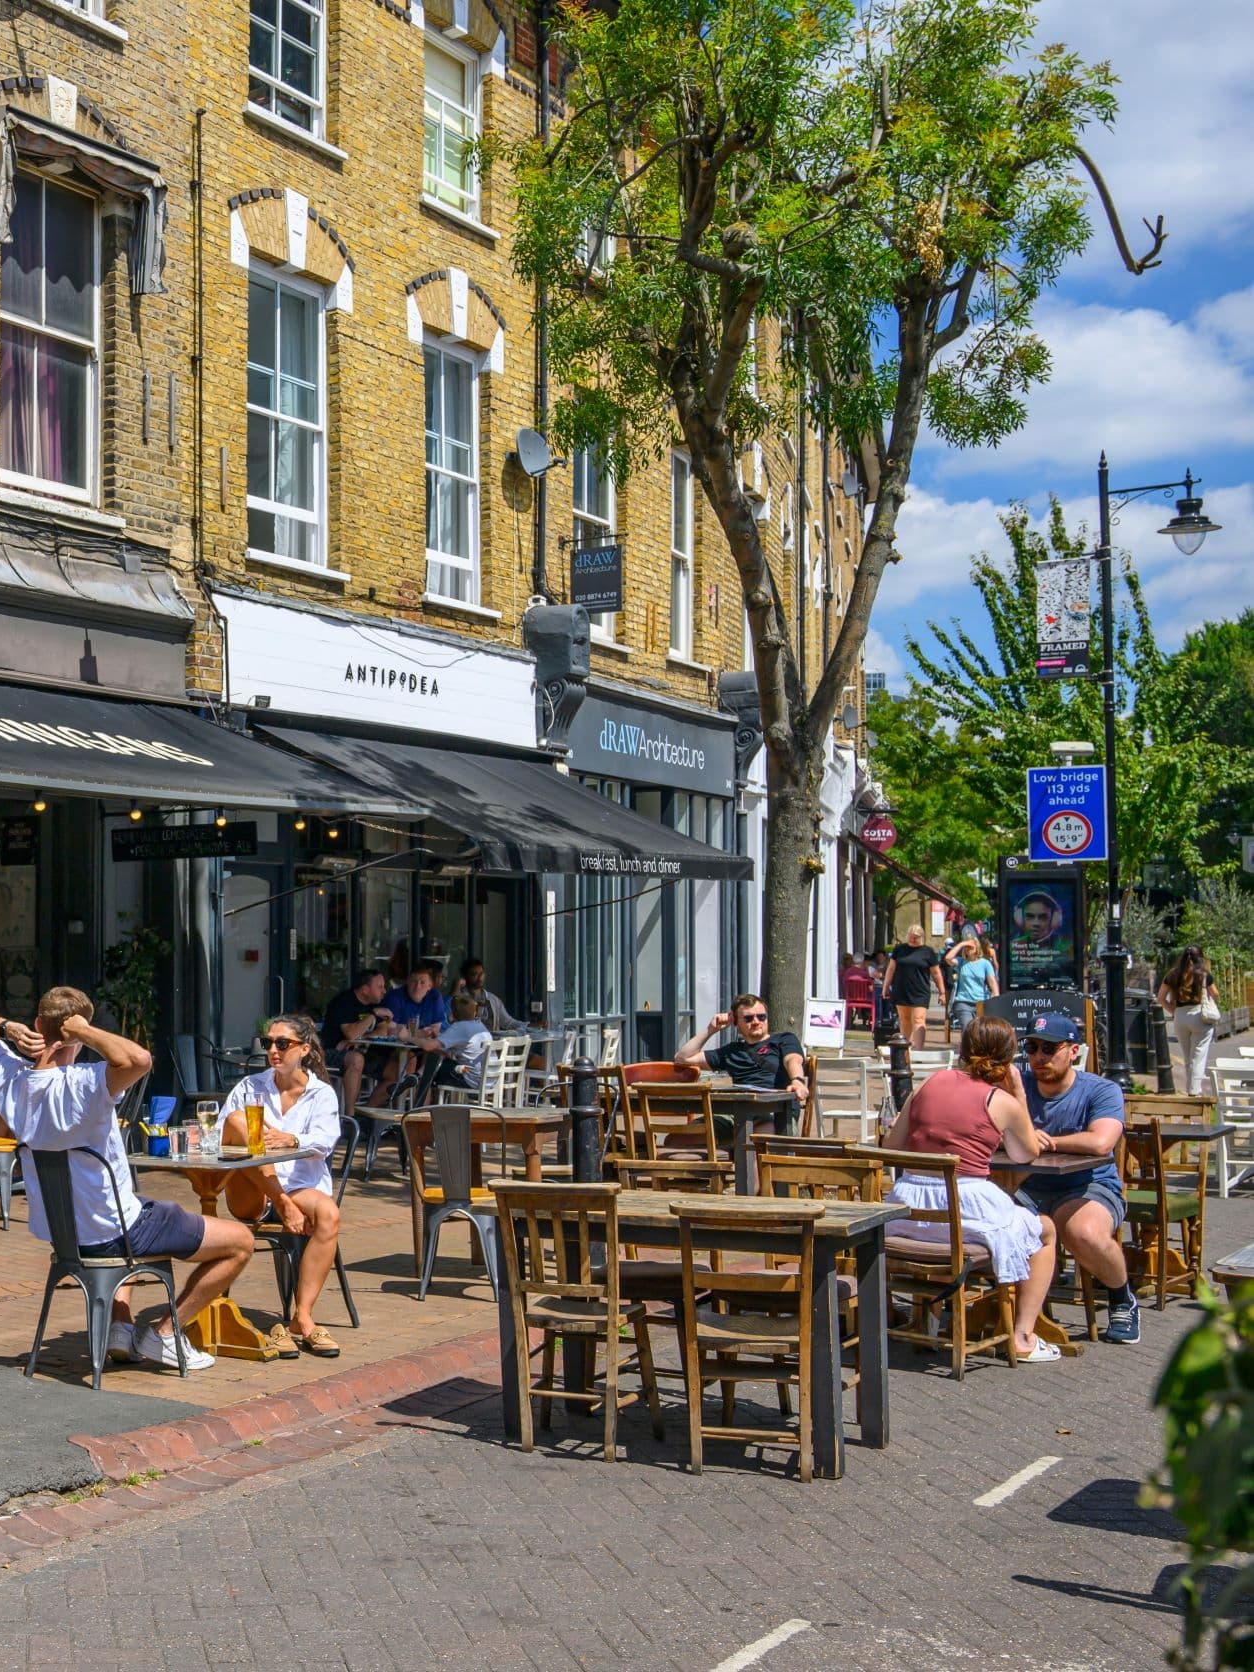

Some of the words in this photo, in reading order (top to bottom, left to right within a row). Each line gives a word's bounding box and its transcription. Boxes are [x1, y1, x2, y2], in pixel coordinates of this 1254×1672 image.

[1039, 642, 1087, 652] FRAMED
[344, 661, 439, 697] ANTIPODEA
[1033, 773, 1057, 783] Low
[1060, 771, 1099, 782] bridge
[1047, 784, 1064, 794] 113
[1069, 783, 1090, 795] yds
[1048, 795, 1086, 806] ahead
[863, 829, 893, 837] COSTA
[579, 851, 619, 873] breakfast,
[619, 855, 642, 872] lunch
[643, 856, 657, 873] and
[658, 856, 681, 874] dinner
